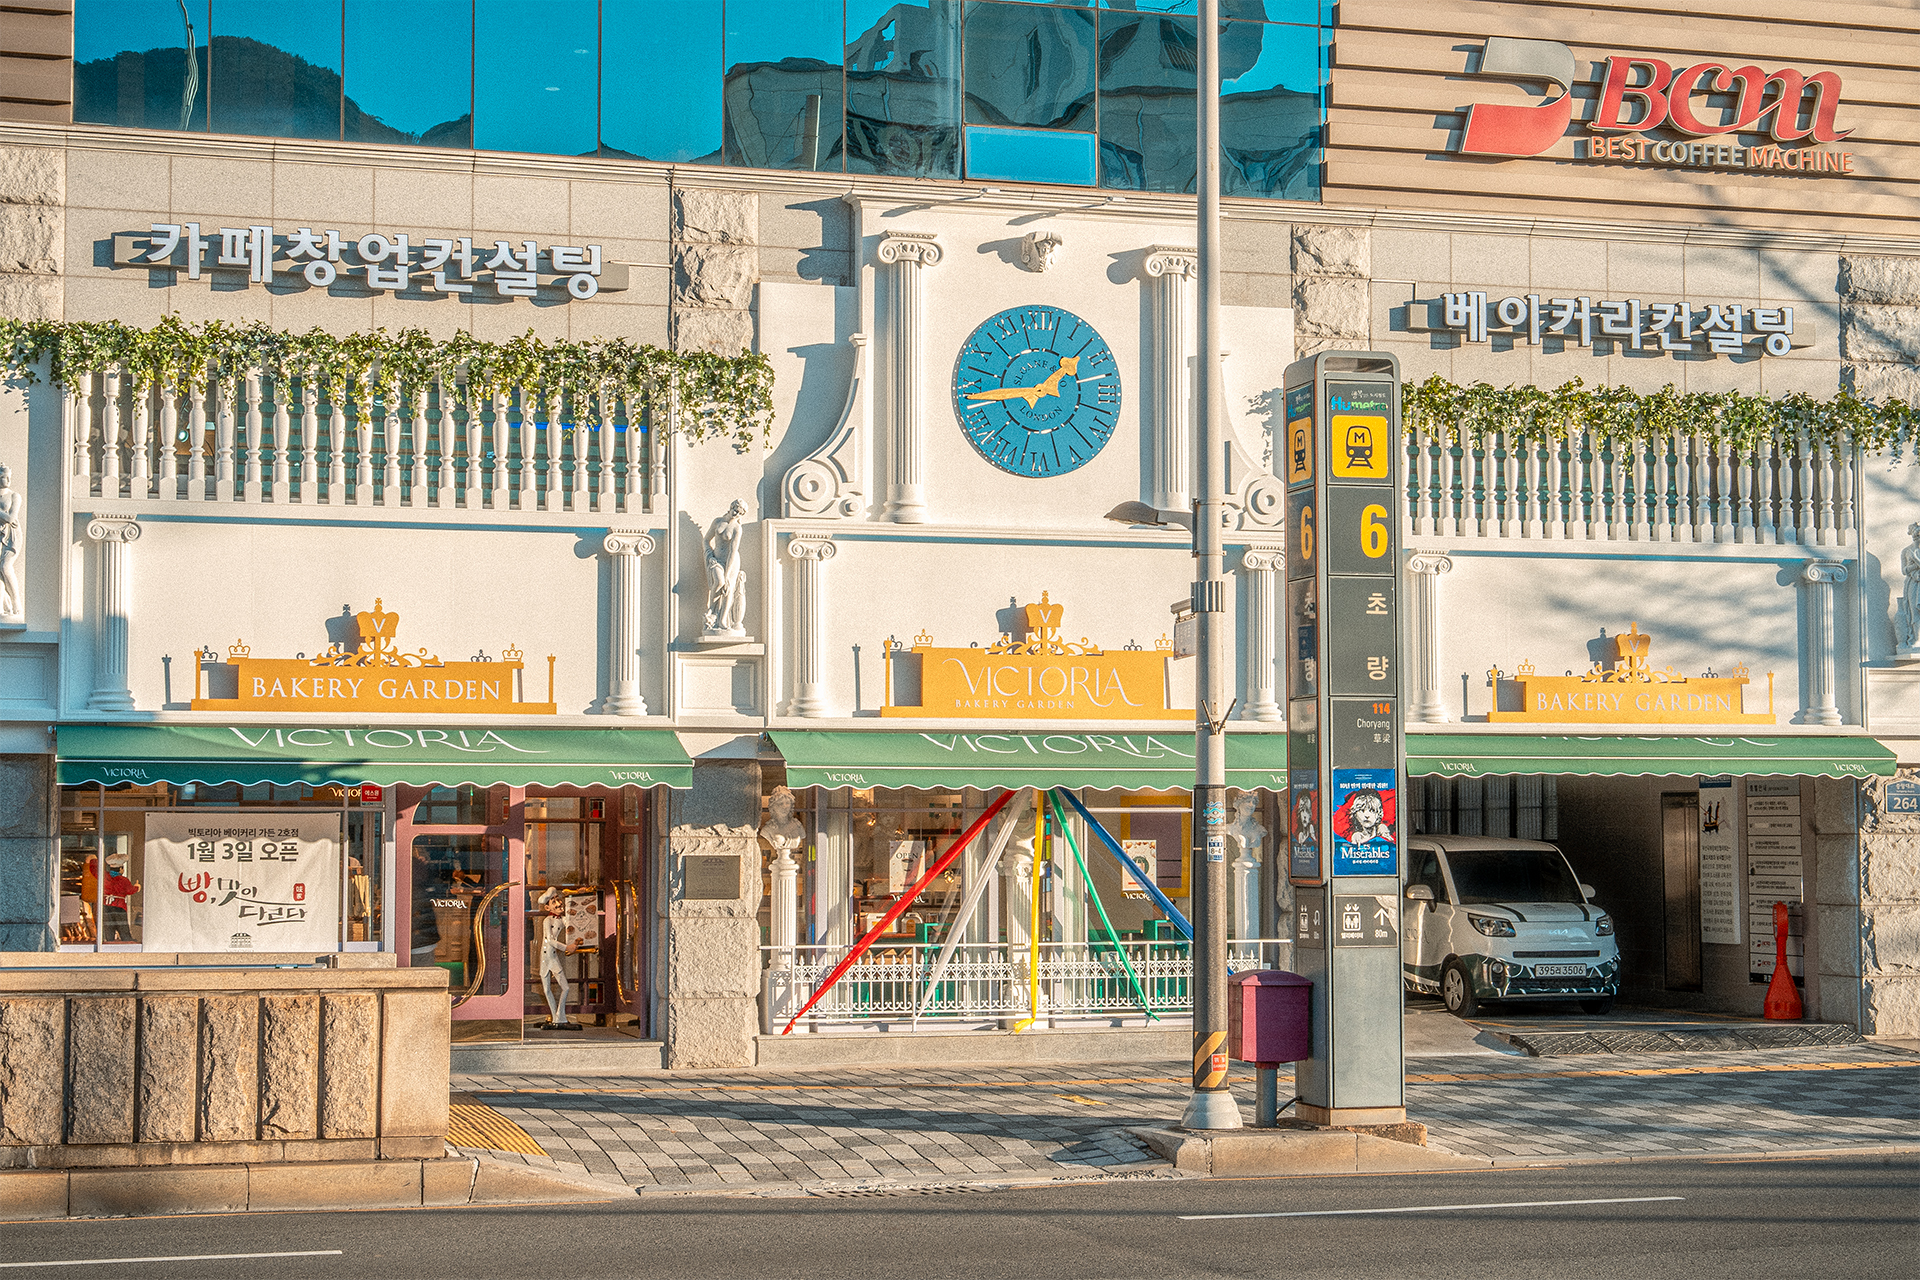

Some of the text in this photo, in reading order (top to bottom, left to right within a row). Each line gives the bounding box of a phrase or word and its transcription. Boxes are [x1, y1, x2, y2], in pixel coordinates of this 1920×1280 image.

[1590, 136, 1855, 174] BEST COFFEE MACHINE
[147, 222, 603, 300] 카페창업컨설팅
[1028, 310, 1054, 331] XII
[1441, 290, 1795, 357] 베이커리컨설팅
[1014, 360, 1049, 386] SLOANE
[1098, 383, 1117, 405] III
[1020, 405, 1063, 422] LONDON
[1300, 505, 1313, 560] 6
[1360, 504, 1389, 559] 6
[371, 616, 387, 634] V
[1039, 609, 1052, 624] V
[1628, 639, 1641, 653] V
[252, 676, 501, 701] BAKERY GARDEN
[942, 657, 1145, 708] VICTORIA
[955, 699, 1075, 709] BAKERY GARDEN
[1372, 703, 1391, 715] 114
[1536, 692, 1732, 712] BAKERY GARDEN
[1356, 718, 1391, 730] Choryang
[228, 726, 552, 753] VICTORIA
[918, 733, 1196, 759] VICTORIA
[101, 766, 150, 779] VICTORIA
[1439, 761, 1478, 773] VICTORIA
[1832, 762, 1869, 773] VICTORIA
[608, 770, 655, 782] VICTORIA
[824, 771, 868, 784] VICTORIA
[1893, 797, 1918, 810] 264
[188, 828, 299, 838] 빅토리아 베이커리 가든 2호점
[187, 841, 299, 862] 1월 3일 오픈
[895, 852, 919, 860] OPEN
[430, 899, 468, 909] VICTORIA
[1562, 965, 1584, 975] 3506
